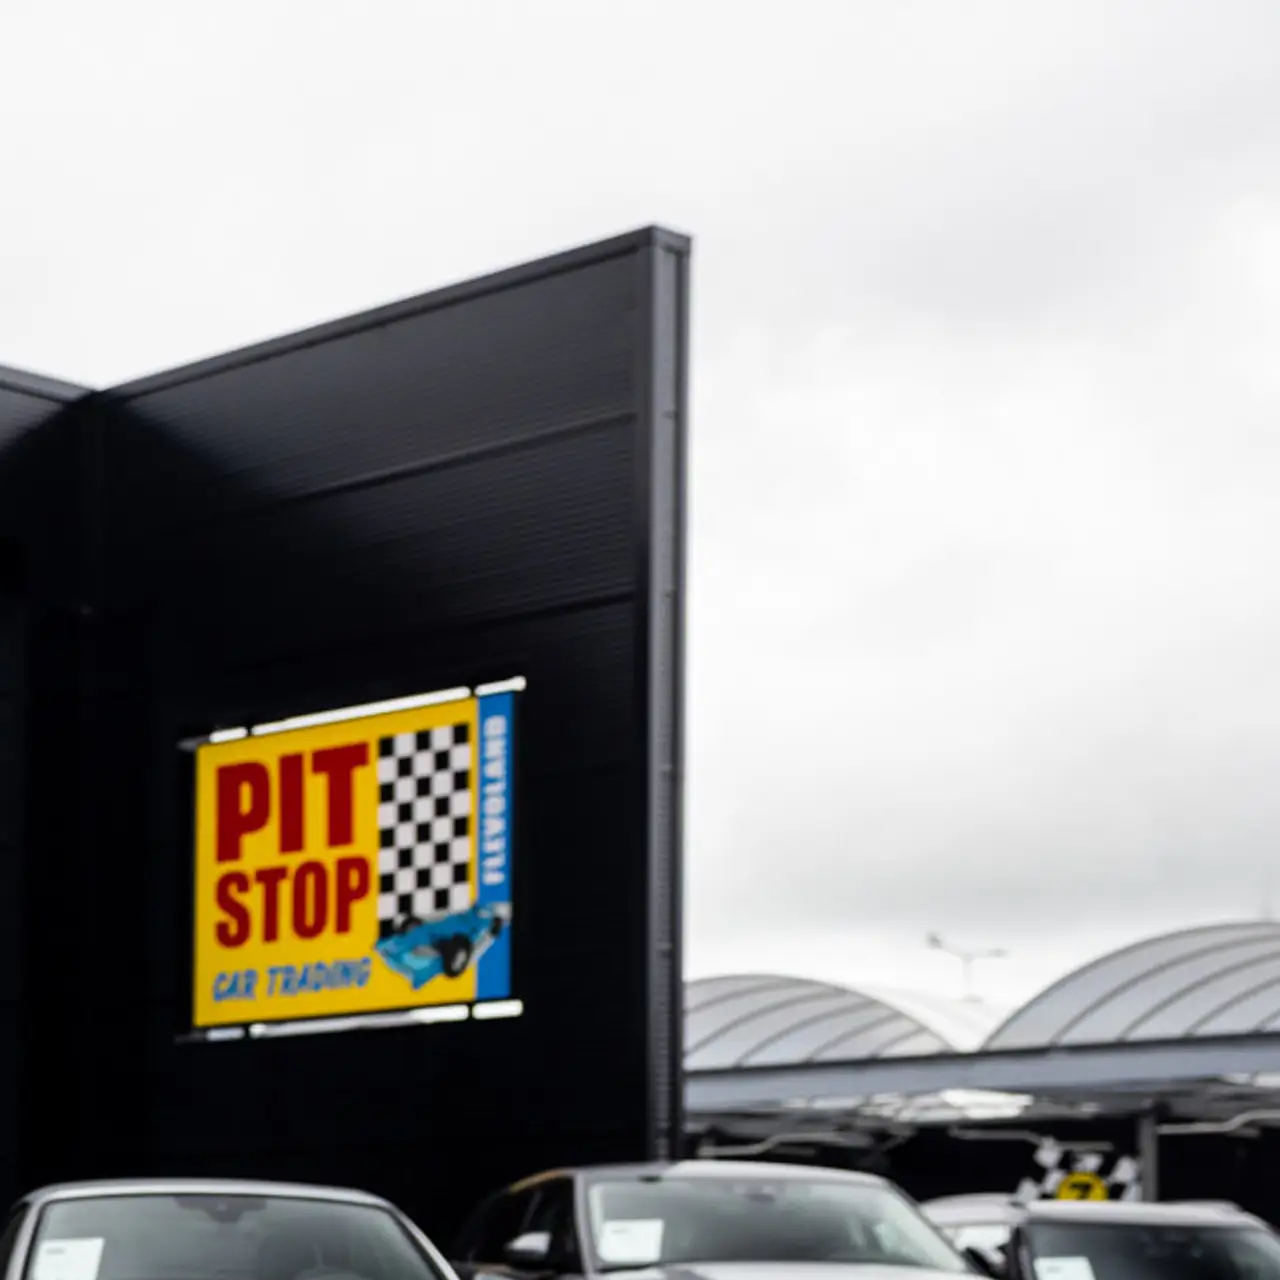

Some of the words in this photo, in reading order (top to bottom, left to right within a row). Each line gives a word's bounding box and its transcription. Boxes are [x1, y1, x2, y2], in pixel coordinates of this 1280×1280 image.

[215, 741, 370, 864] PIT
[214, 855, 371, 950] STOP
[212, 968, 258, 1003] CAR
